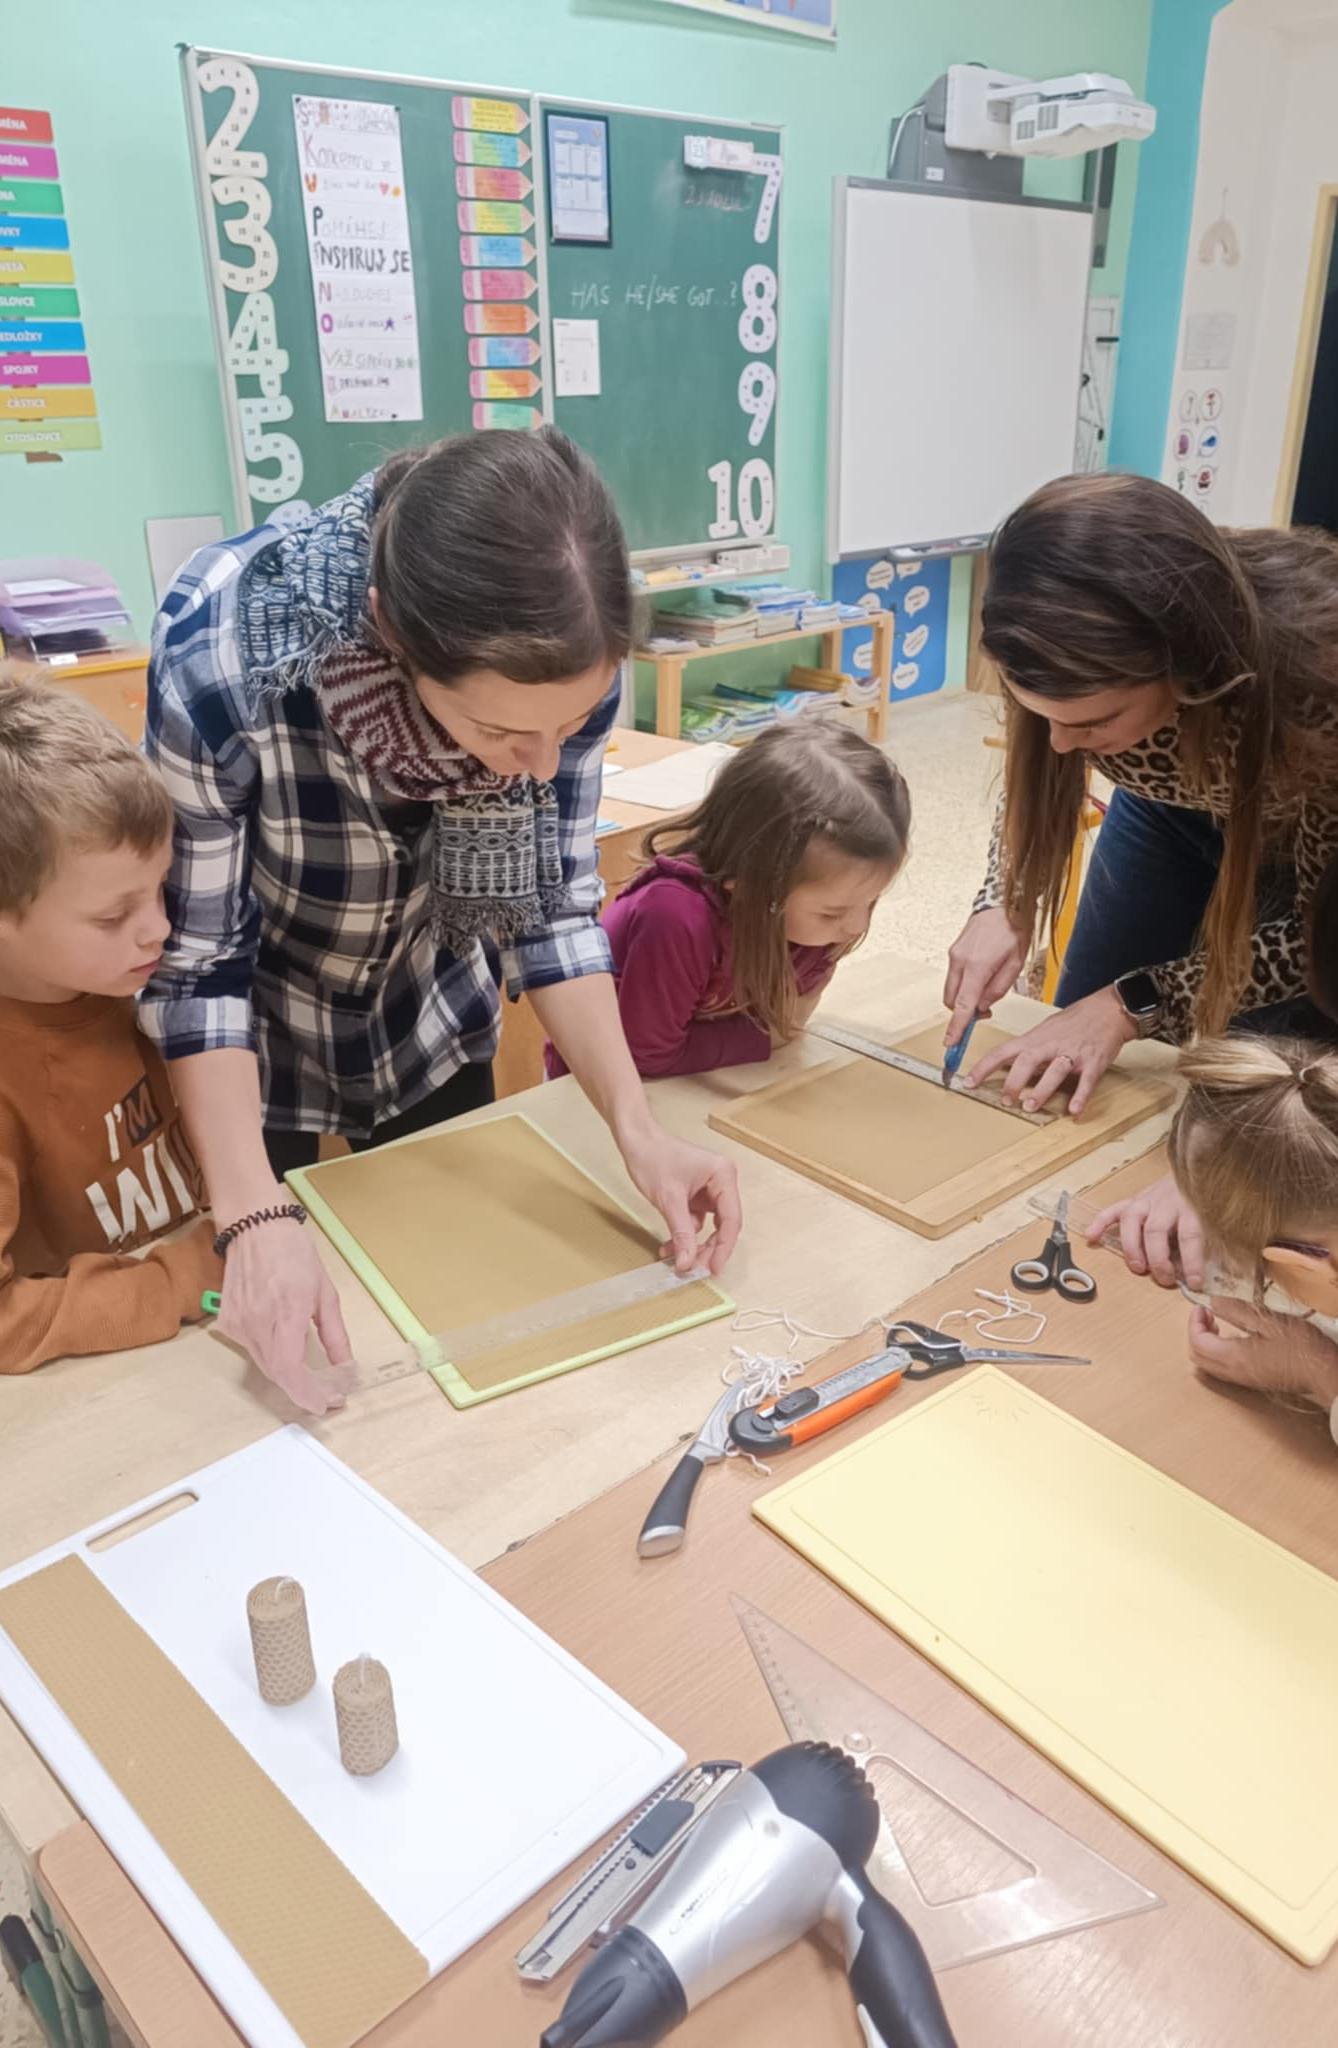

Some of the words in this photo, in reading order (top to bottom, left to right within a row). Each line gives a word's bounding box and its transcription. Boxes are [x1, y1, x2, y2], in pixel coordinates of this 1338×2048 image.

[389, 249, 411, 274] SE
[571, 283, 610, 311] HAS
[738, 264, 777, 353] 8
[3, 365, 39, 375] SPOJKY
[738, 361, 776, 446] 9
[707, 458, 775, 539] 10
[104, 1078, 163, 1163] I'M
